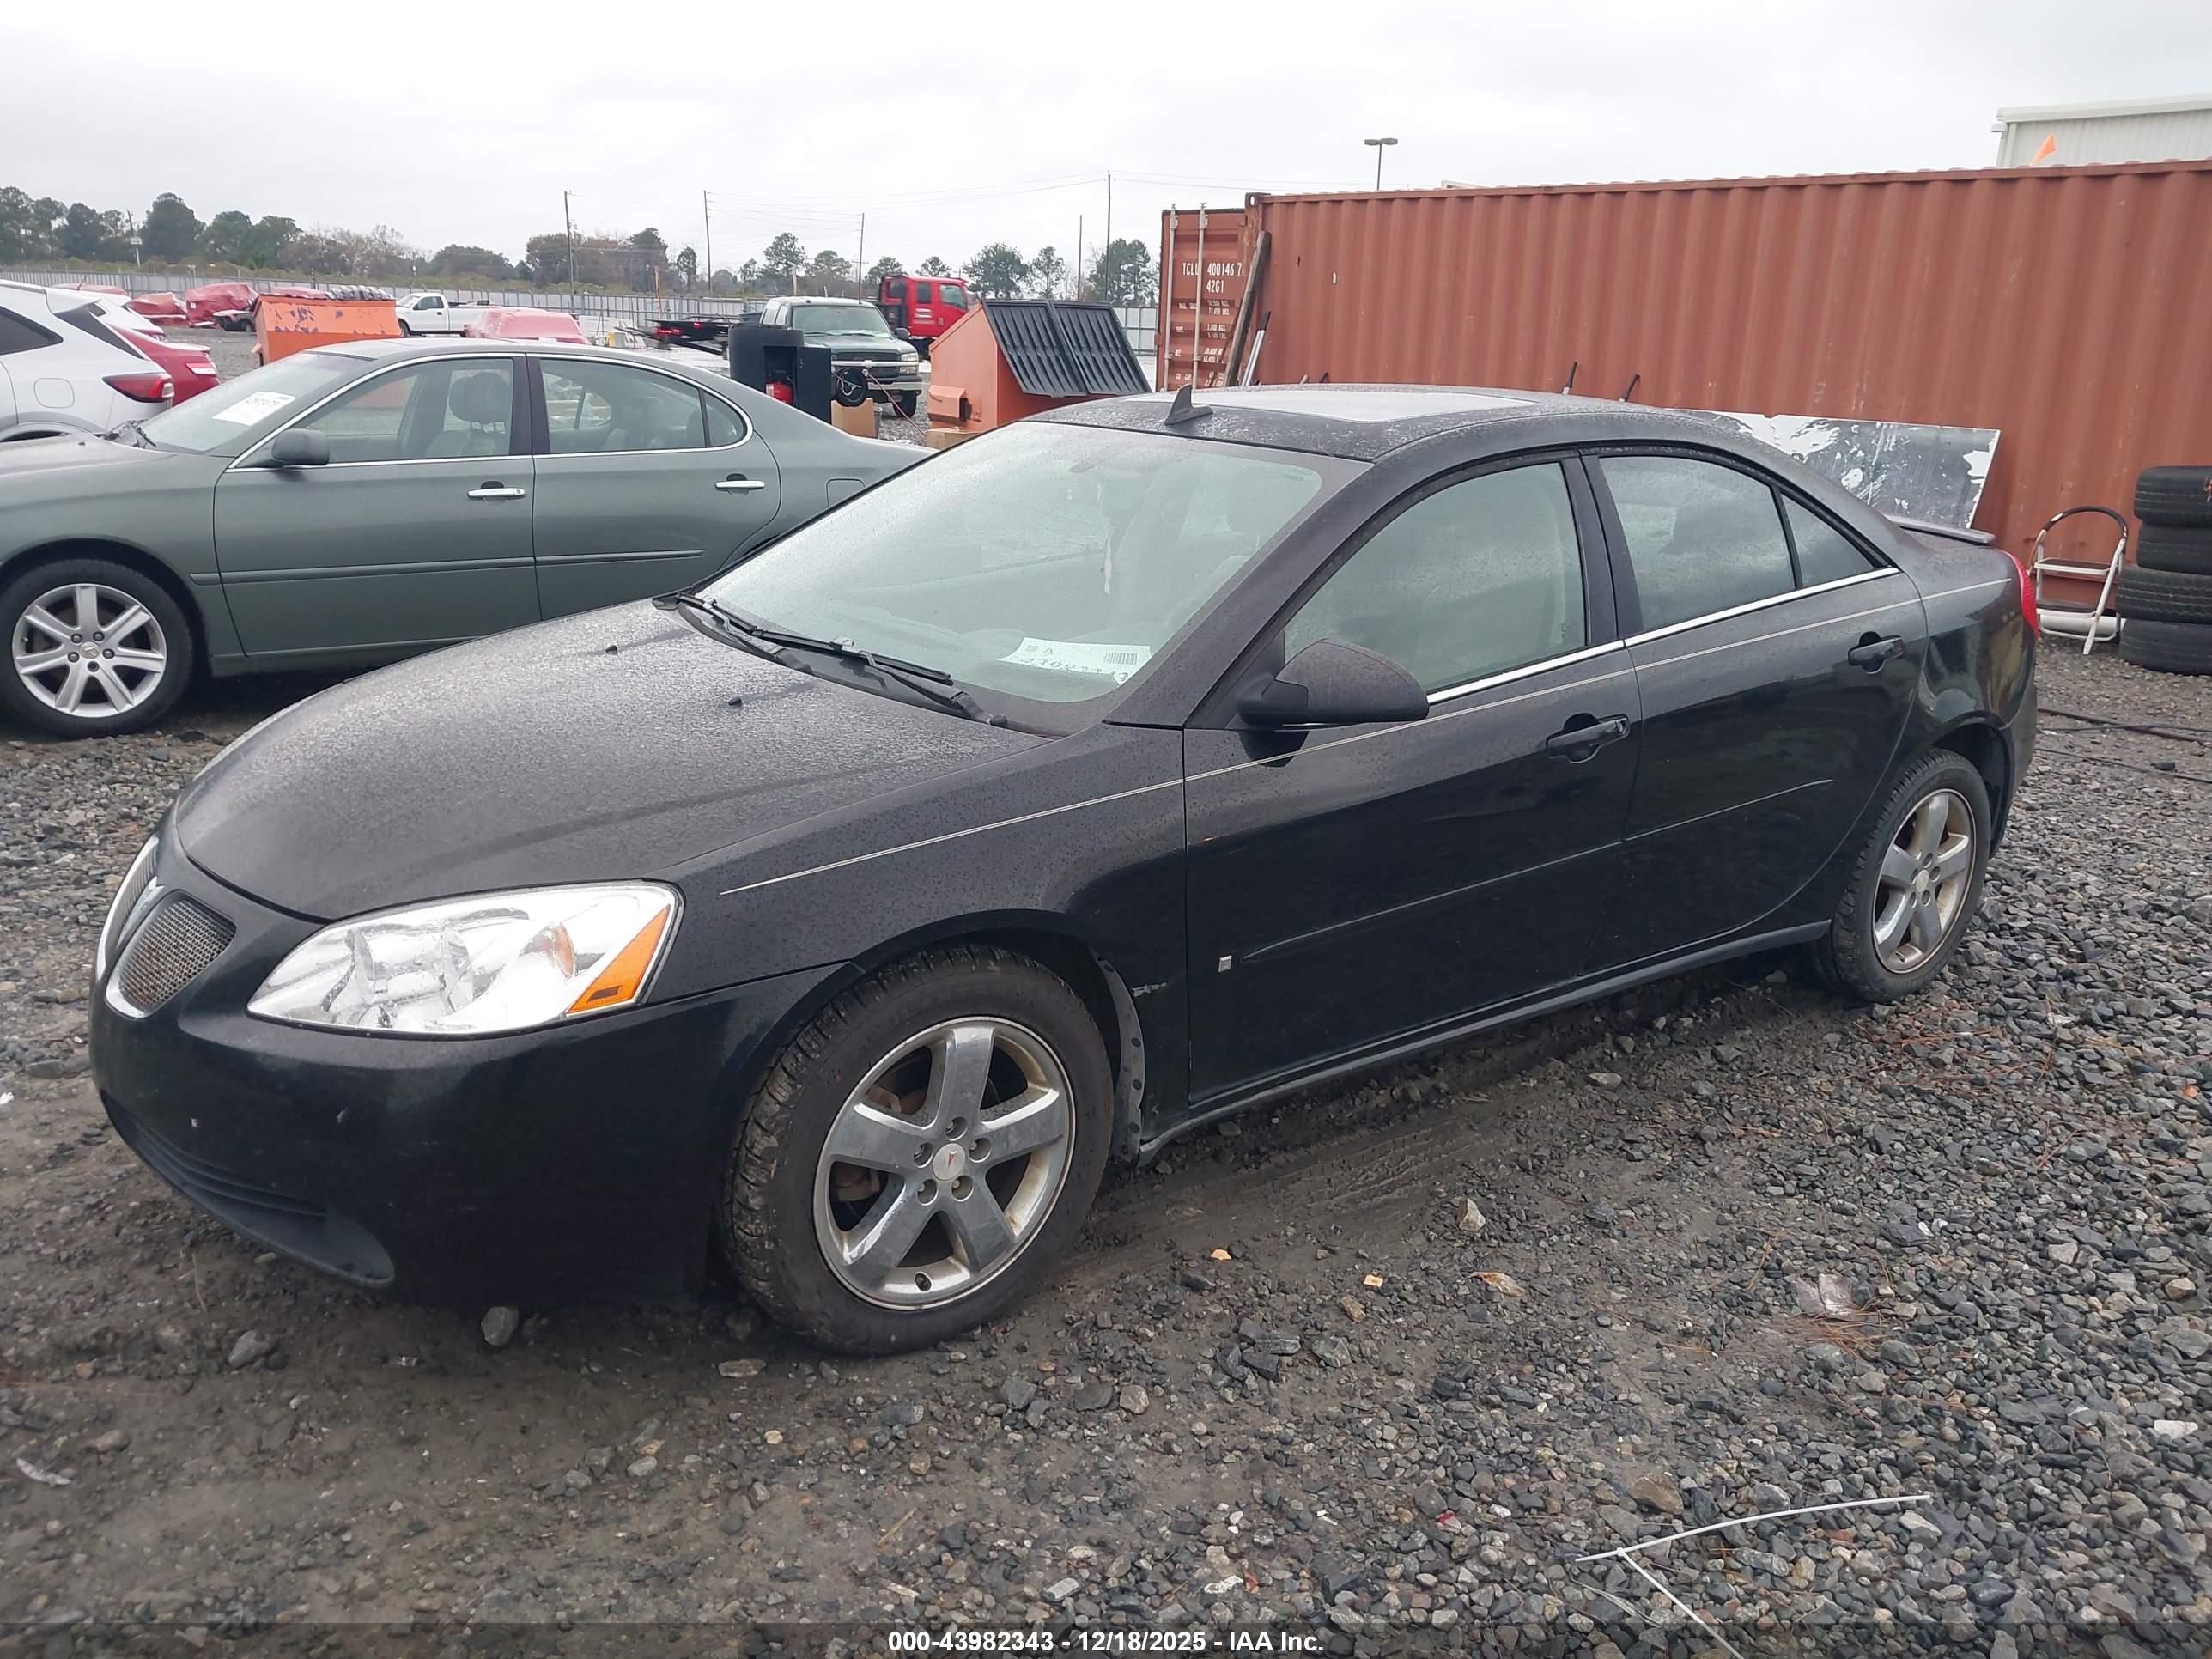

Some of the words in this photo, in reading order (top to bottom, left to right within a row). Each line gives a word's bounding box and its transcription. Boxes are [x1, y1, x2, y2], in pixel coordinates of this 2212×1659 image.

[1206, 263, 1235, 276] 400146
[1237, 262, 1243, 277] 7
[1206, 279, 1224, 294] 42G1
